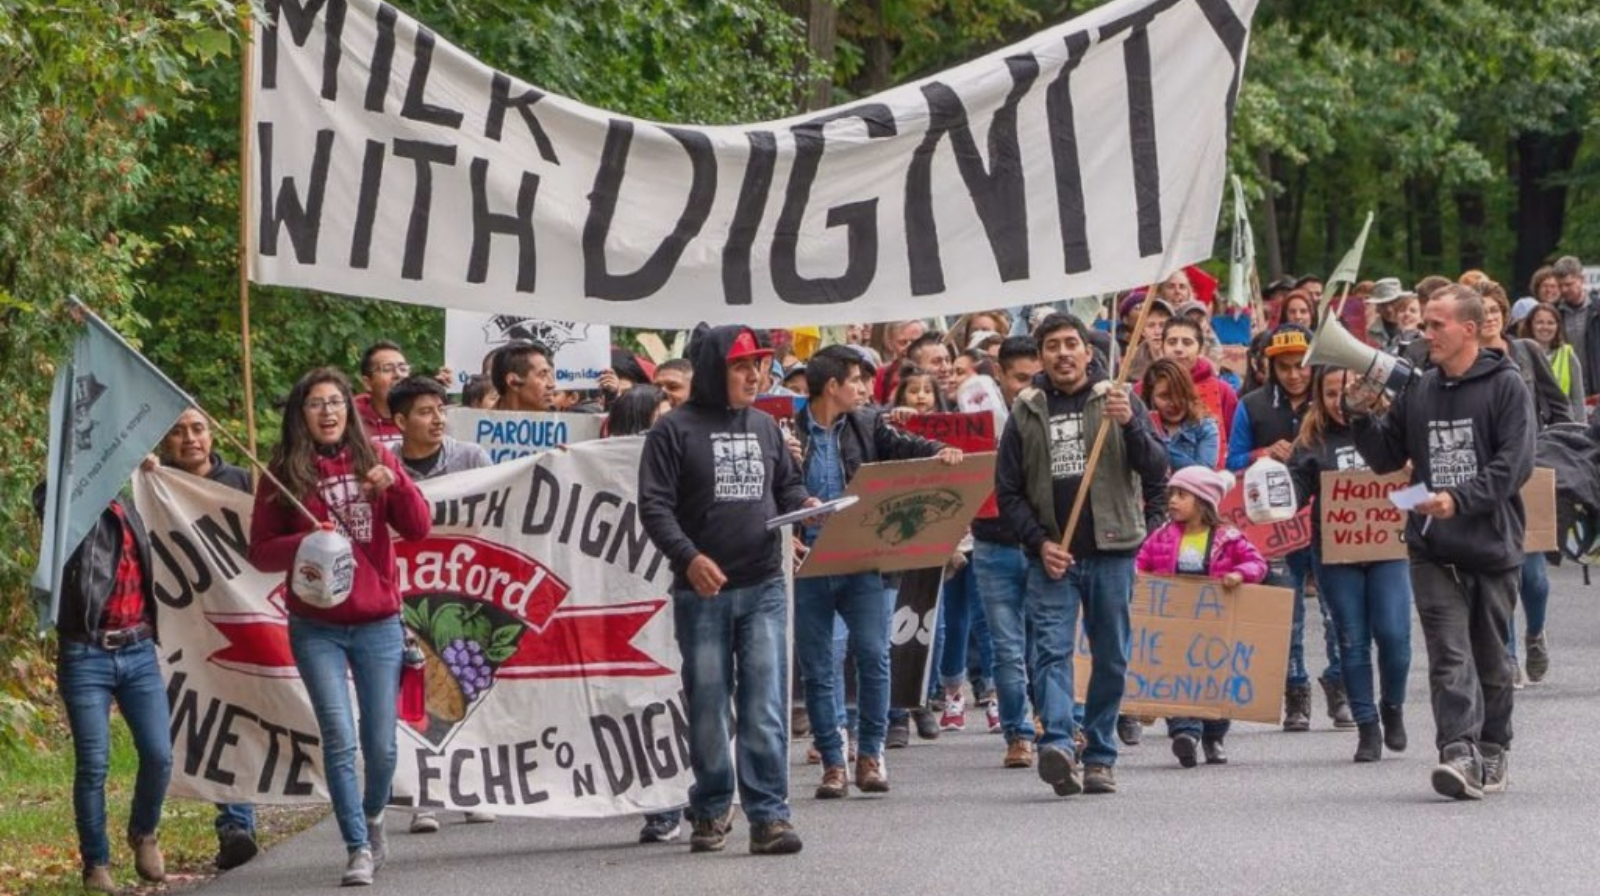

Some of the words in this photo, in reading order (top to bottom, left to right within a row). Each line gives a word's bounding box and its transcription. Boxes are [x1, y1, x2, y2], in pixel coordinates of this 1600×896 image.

[259, 0, 561, 166] MILK
[256, 121, 540, 294] WITH
[1326, 507, 1358, 524] No
[1333, 522, 1389, 545] visto
[1194, 585, 1224, 619] A
[1186, 632, 1255, 676] CON
